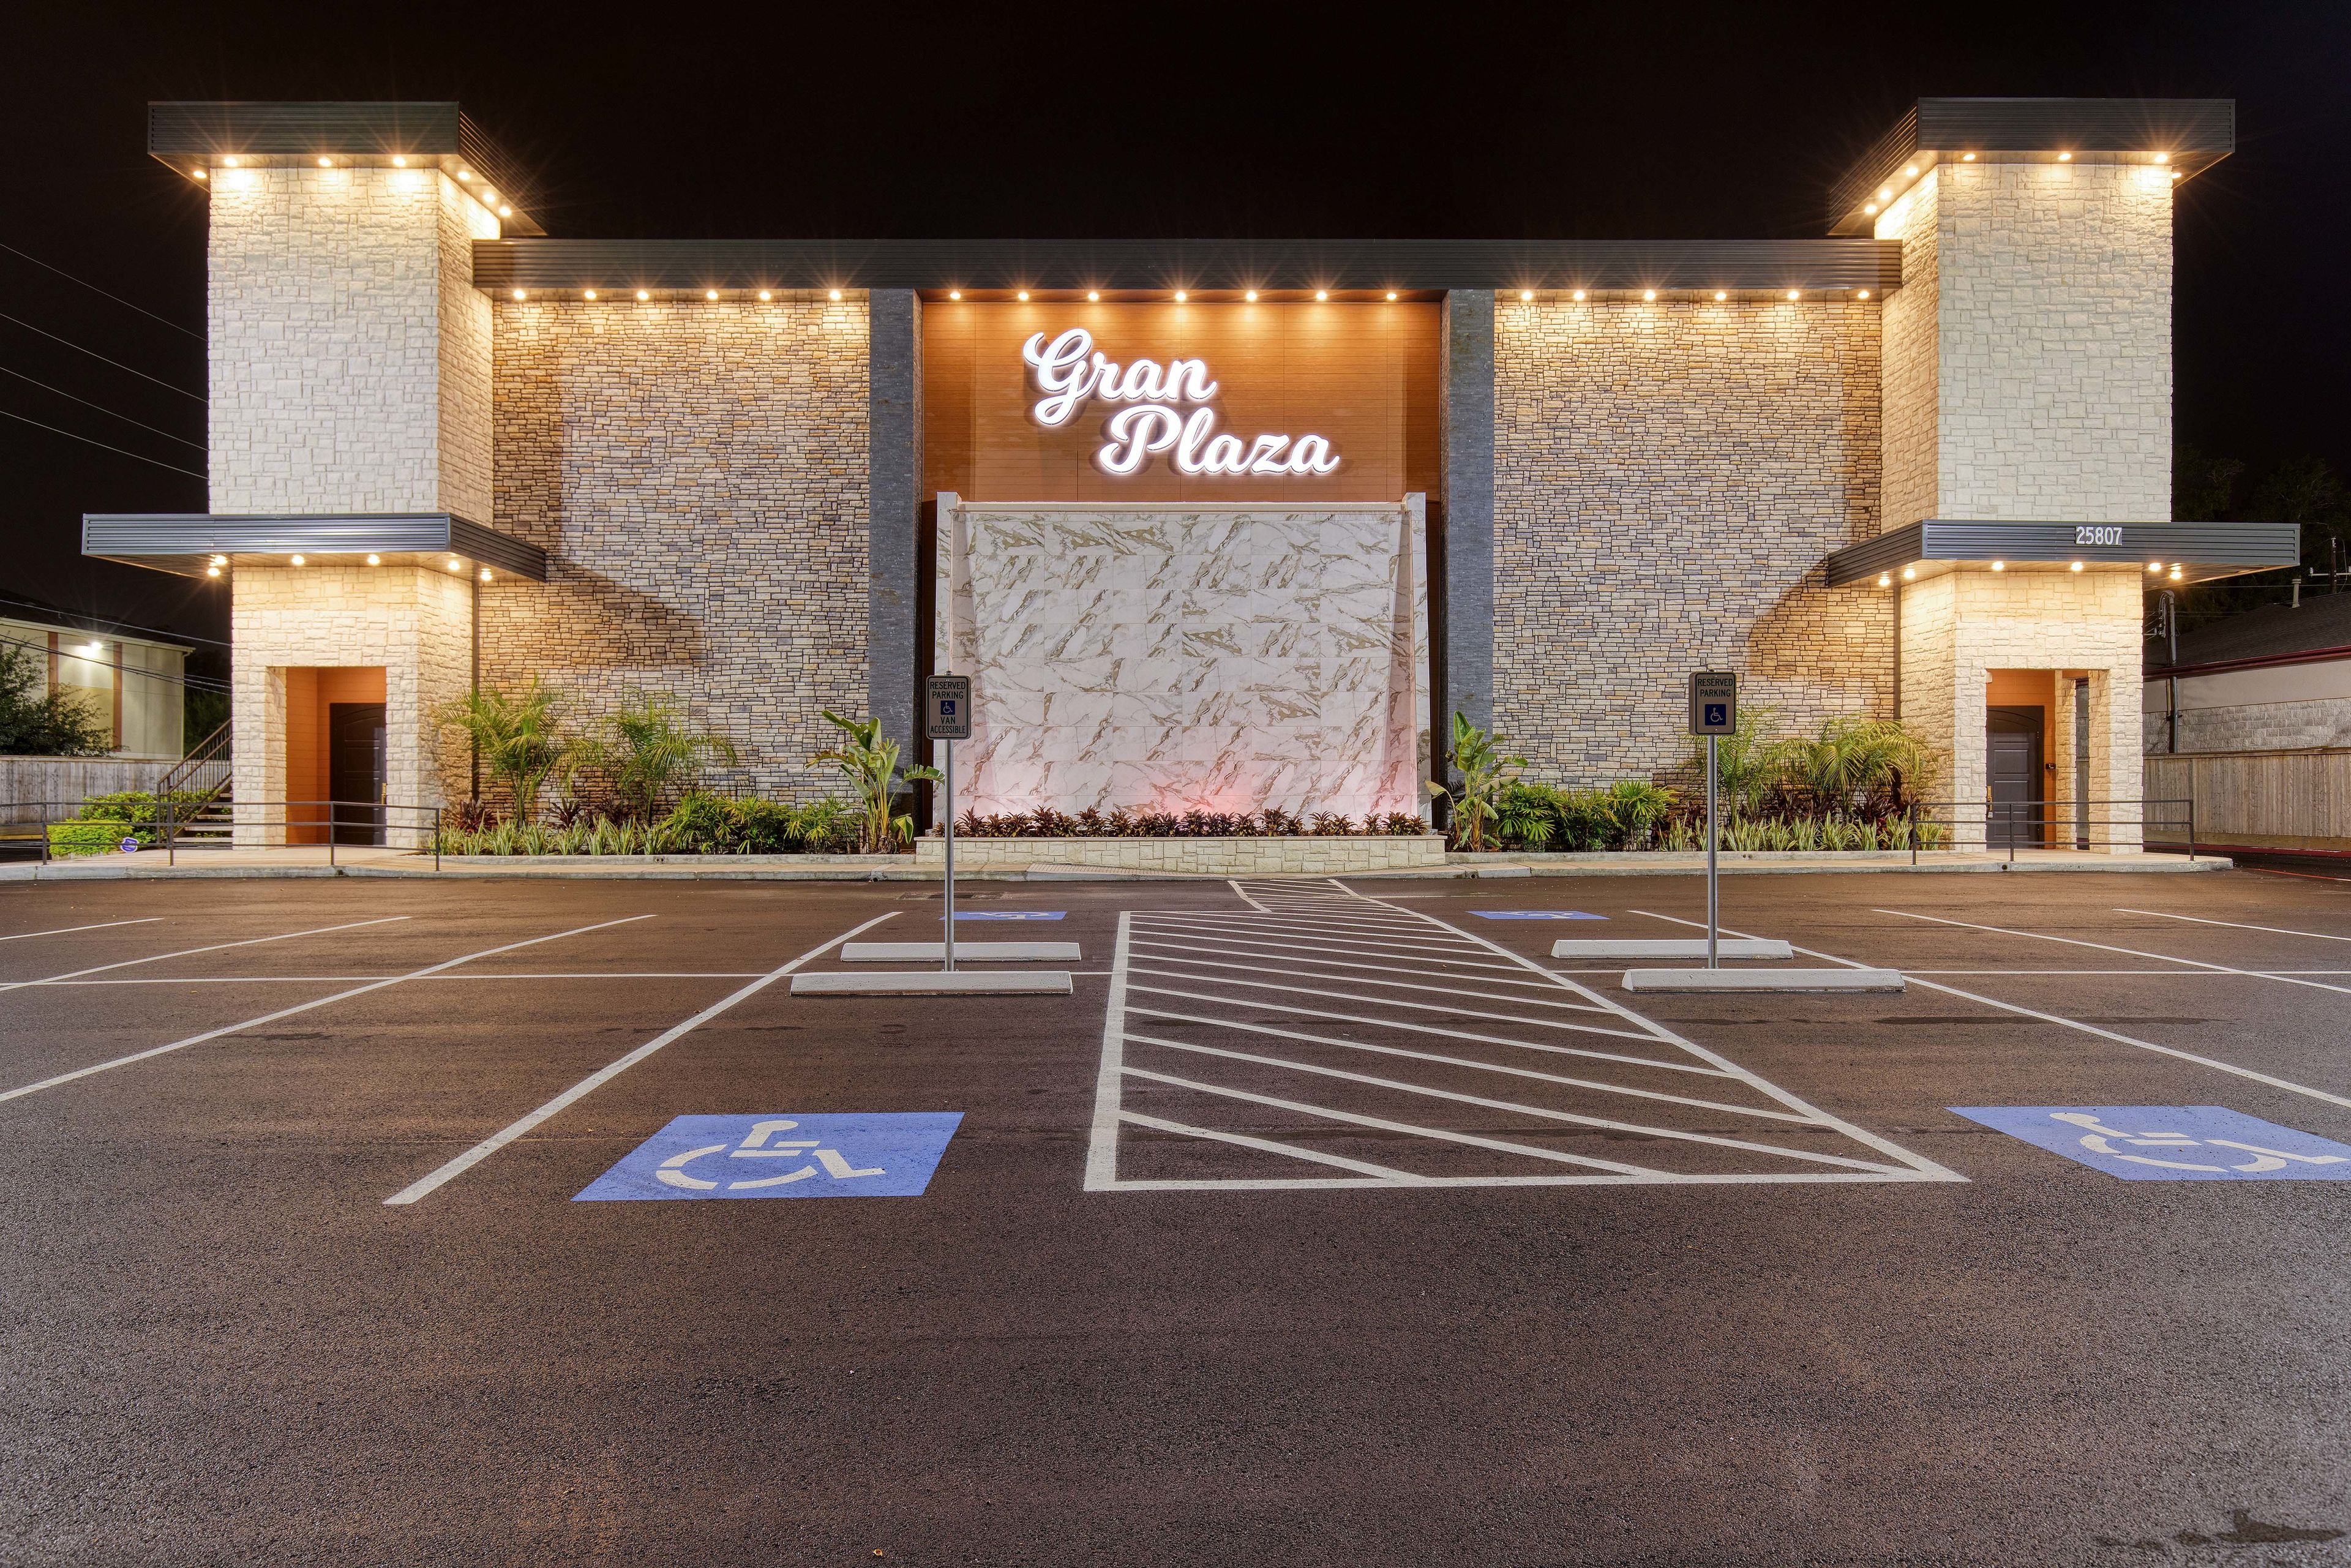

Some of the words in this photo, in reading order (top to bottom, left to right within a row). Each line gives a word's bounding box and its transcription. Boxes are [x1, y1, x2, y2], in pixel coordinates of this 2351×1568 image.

[1023, 328, 1217, 425] Gran
[1100, 405, 1340, 473] Plaza
[2076, 527, 2122, 545] 25807
[1700, 689, 1731, 697] PARKING
